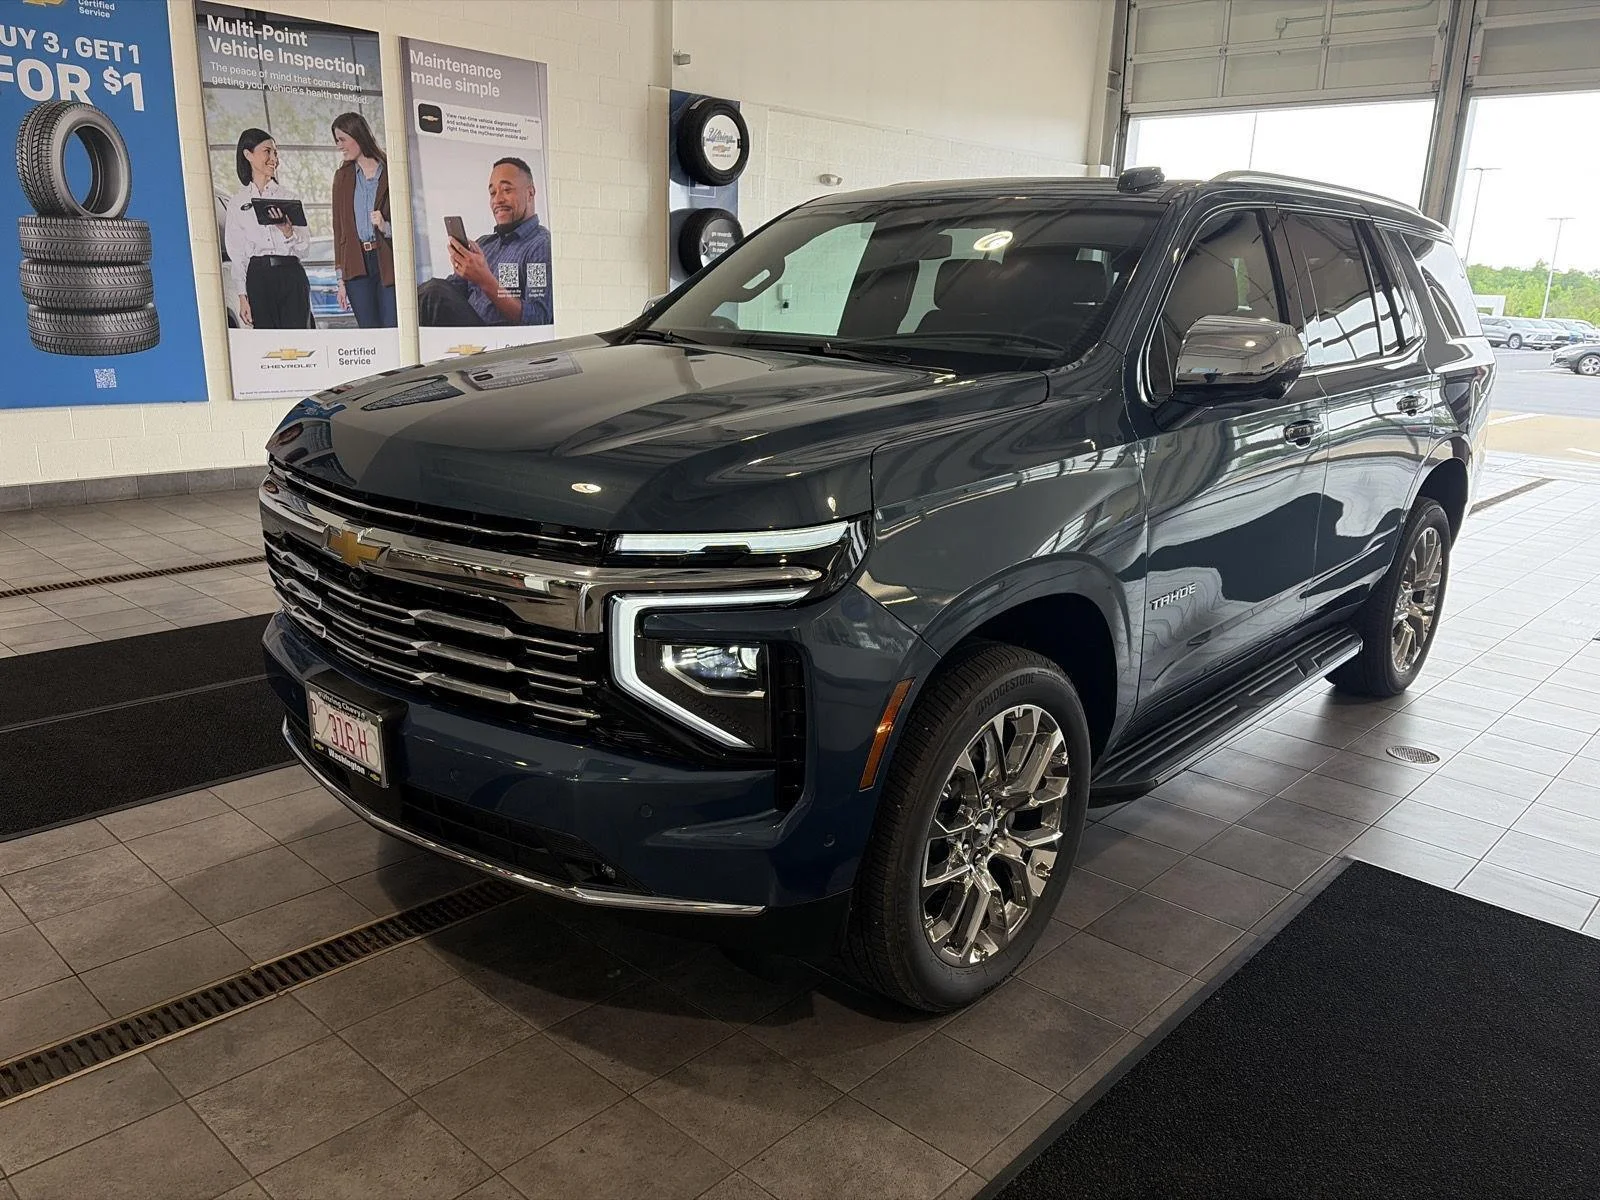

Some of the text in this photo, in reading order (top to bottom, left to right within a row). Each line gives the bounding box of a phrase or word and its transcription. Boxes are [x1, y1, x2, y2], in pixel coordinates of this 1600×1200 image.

[78, 0, 115, 10] Certified
[79, 7, 110, 18] Service
[0, 24, 140, 64] UY 3, GET 1
[206, 14, 308, 47] Multi-Point
[208, 36, 365, 76] Vehicle Inspection
[410, 49, 502, 80] Maintenance
[103, 66, 144, 112] $1
[209, 61, 362, 92] The peace of mind that comes from
[211, 75, 370, 105] getting your vehicle's health checked.
[411, 71, 500, 98] made simple
[456, 120, 476, 128] schedule
[496, 126, 522, 134] appointment
[458, 114, 478, 122] real-time
[479, 117, 493, 125] vehicle
[337, 347, 377, 357] Certified
[338, 357, 372, 366] Service
[1150, 582, 1197, 610] TAHOE
[977, 672, 1036, 718] BRIDGESTONE
[329, 713, 370, 762] 316 H
[327, 747, 366, 775] Washington
